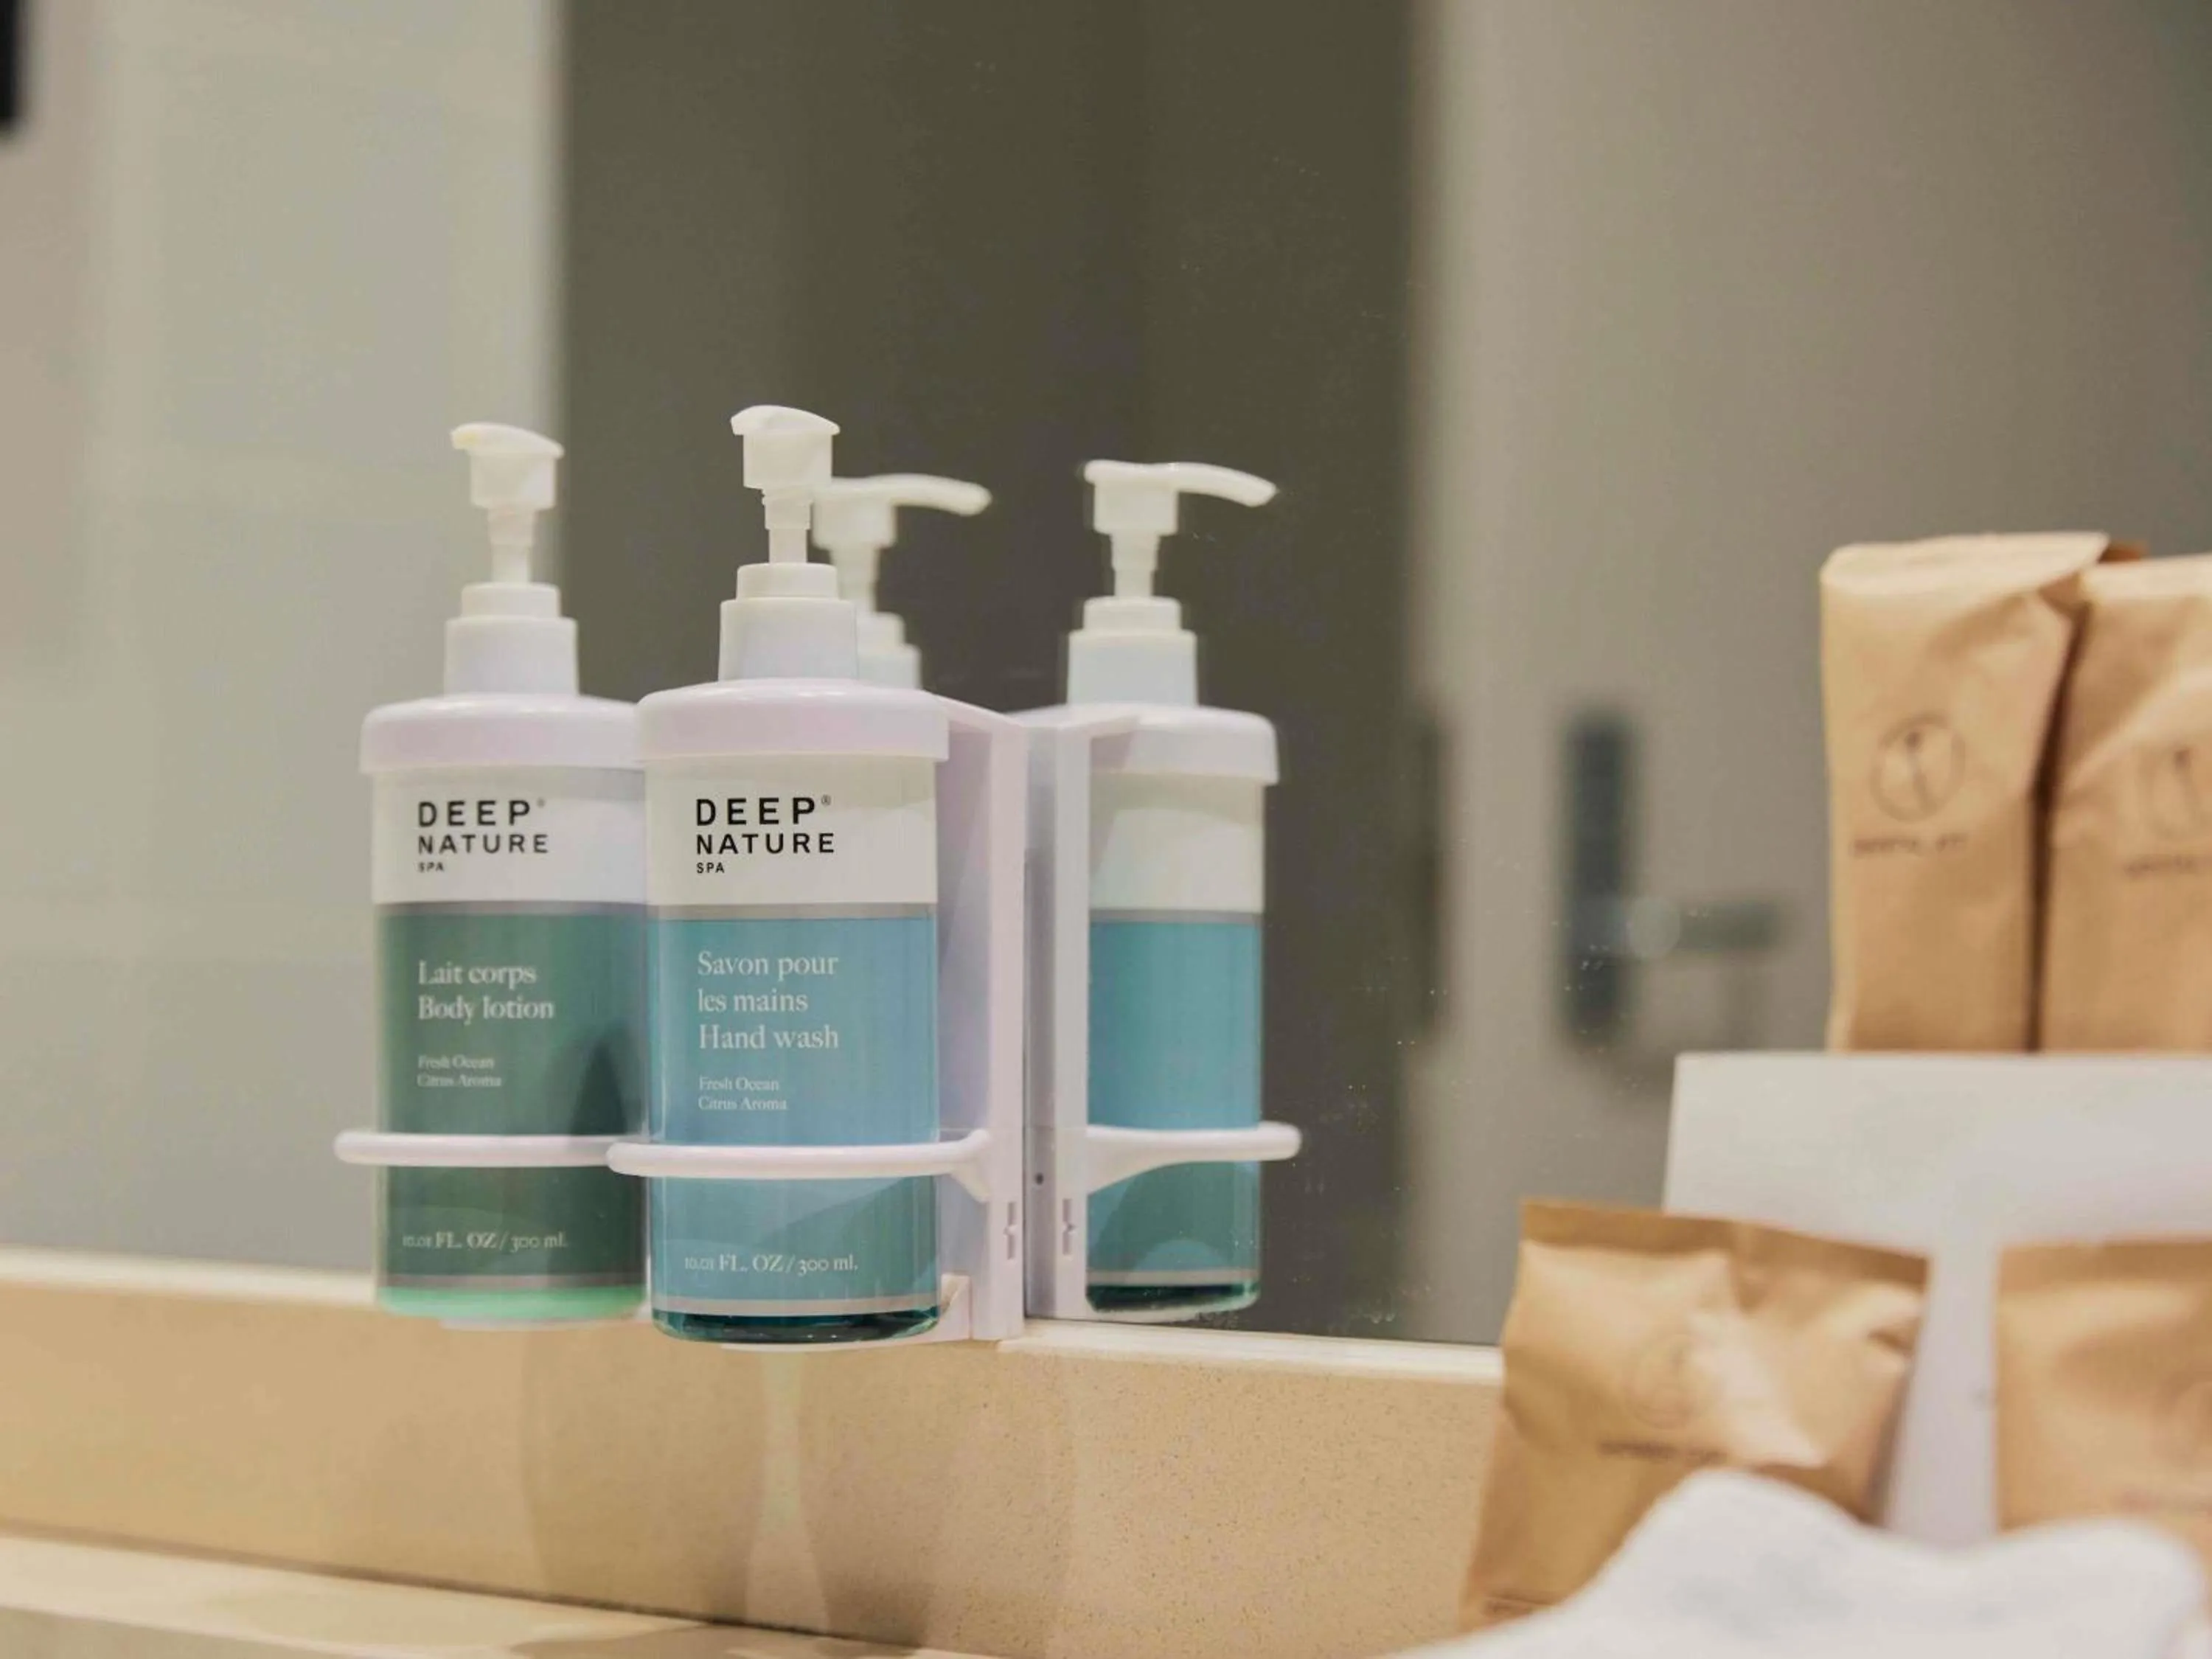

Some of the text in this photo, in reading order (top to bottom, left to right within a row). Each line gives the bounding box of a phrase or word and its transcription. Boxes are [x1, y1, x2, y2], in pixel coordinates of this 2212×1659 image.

[418, 834, 549, 855] NATURE
[696, 832, 835, 855] NATURE
[417, 861, 444, 872] SPA
[696, 862, 725, 874] SPA
[418, 959, 538, 990] Lait corps
[698, 950, 839, 982] Savon pour
[418, 995, 554, 1026] Body lotion
[698, 987, 808, 1012] les mains
[699, 1023, 839, 1049] Hand wash
[418, 1054, 494, 1069] Fresh Ocean
[699, 1076, 779, 1091] Fresh Ocean
[698, 1096, 787, 1110] Citrus Aroma
[467, 1231, 496, 1248] OZ
[752, 1254, 784, 1272] OZ
[797, 1259, 830, 1277] 300
